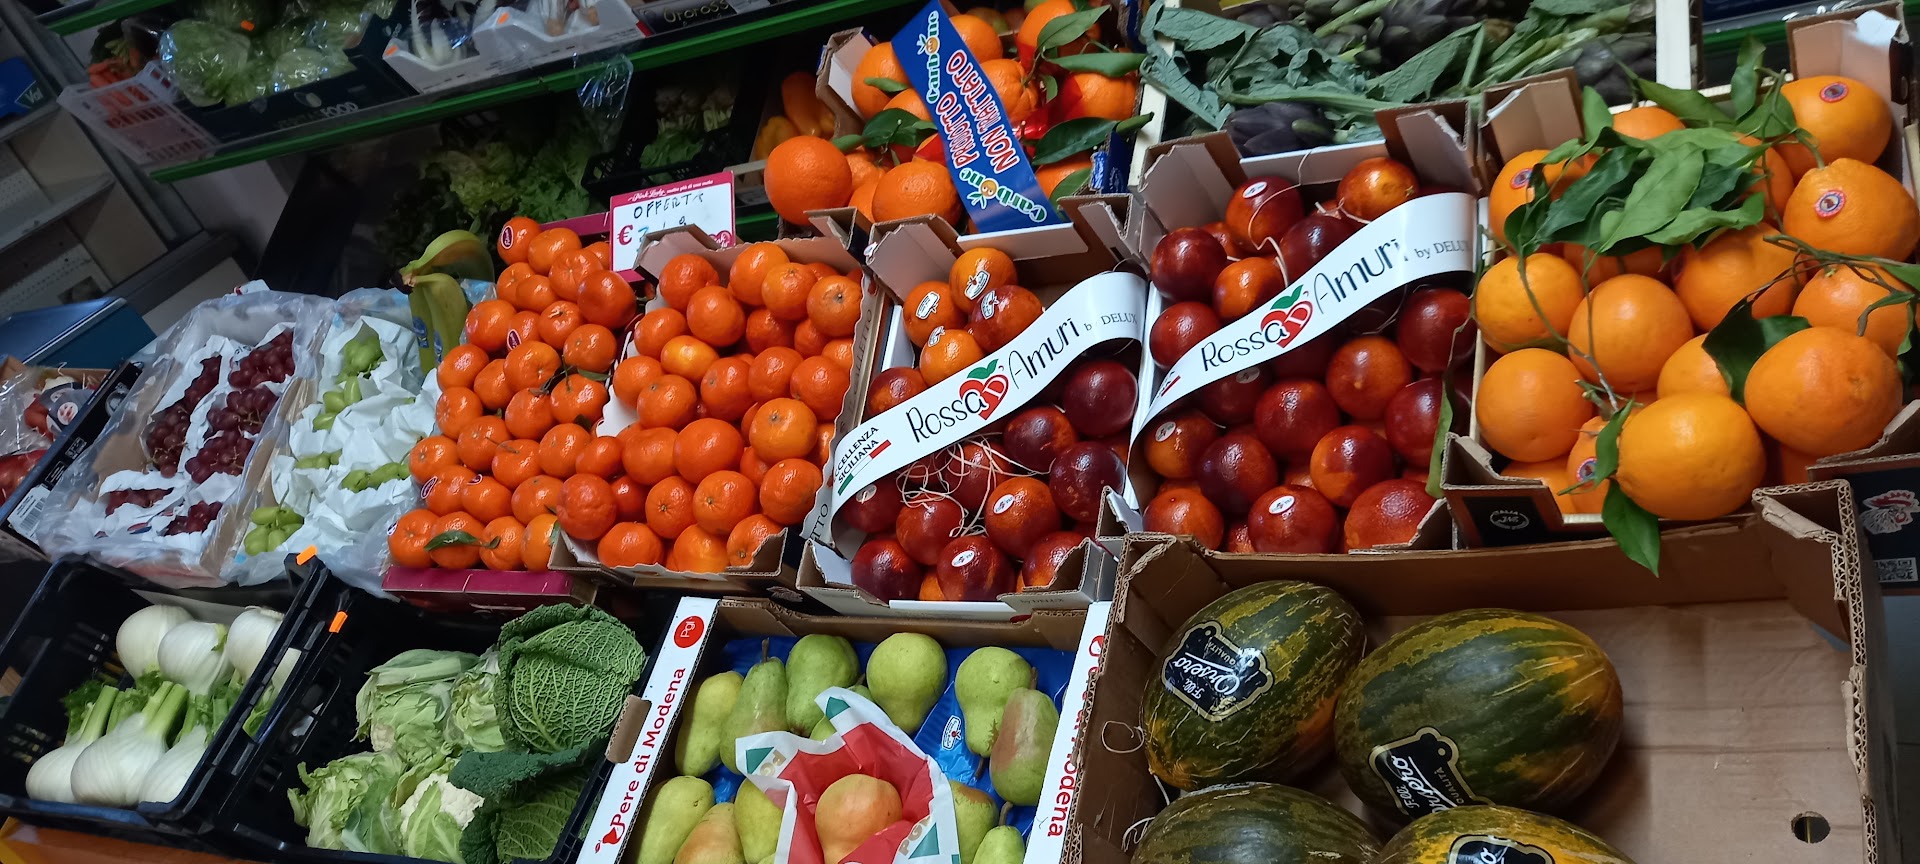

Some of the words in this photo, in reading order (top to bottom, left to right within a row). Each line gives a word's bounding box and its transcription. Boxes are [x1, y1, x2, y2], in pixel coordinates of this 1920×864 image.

[946, 49, 1002, 133] TRATTATO
[936, 91, 980, 169] PRODOTTO
[980, 125, 1020, 174] NON
[1200, 322, 1288, 372] Rossa
[905, 390, 988, 444] Rossa
[838, 439, 880, 484] SICILIANA
[610, 780, 640, 832] Pere
[634, 753, 651, 774] di
[643, 667, 686, 748] Modena
[1047, 753, 1078, 837] odena
